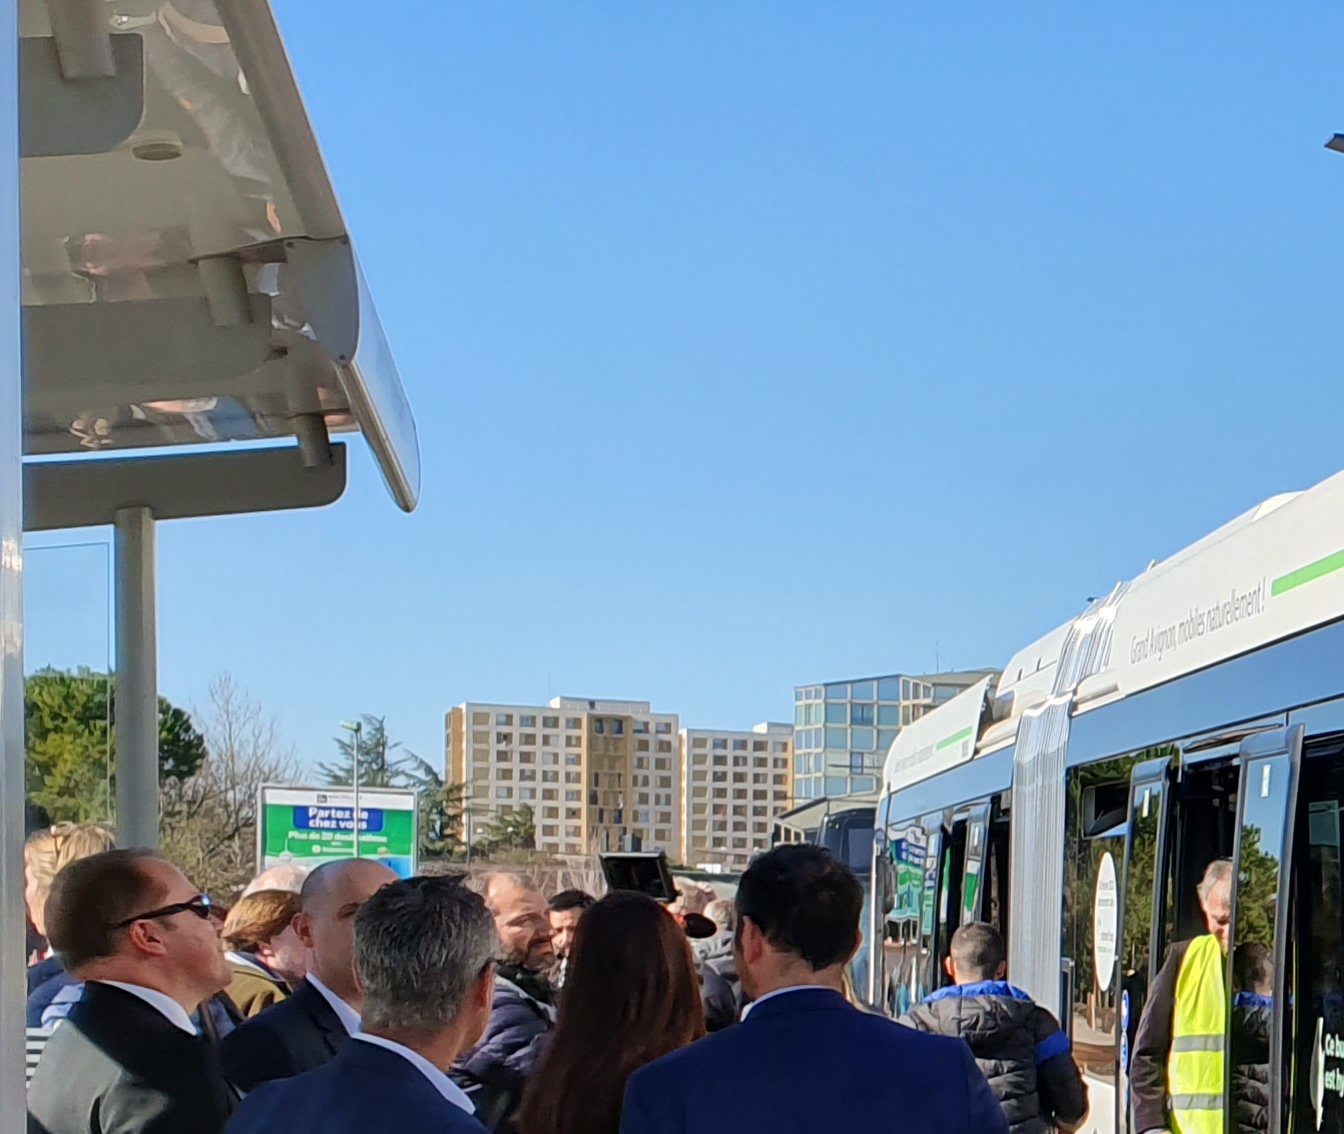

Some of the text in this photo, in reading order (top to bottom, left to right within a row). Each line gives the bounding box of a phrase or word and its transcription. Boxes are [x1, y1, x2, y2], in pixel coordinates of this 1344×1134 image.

[308, 806, 351, 819] Partez
[308, 816, 337, 829] chez
[1324, 1032, 1335, 1057] Ce
[1324, 1069, 1336, 1091] est
